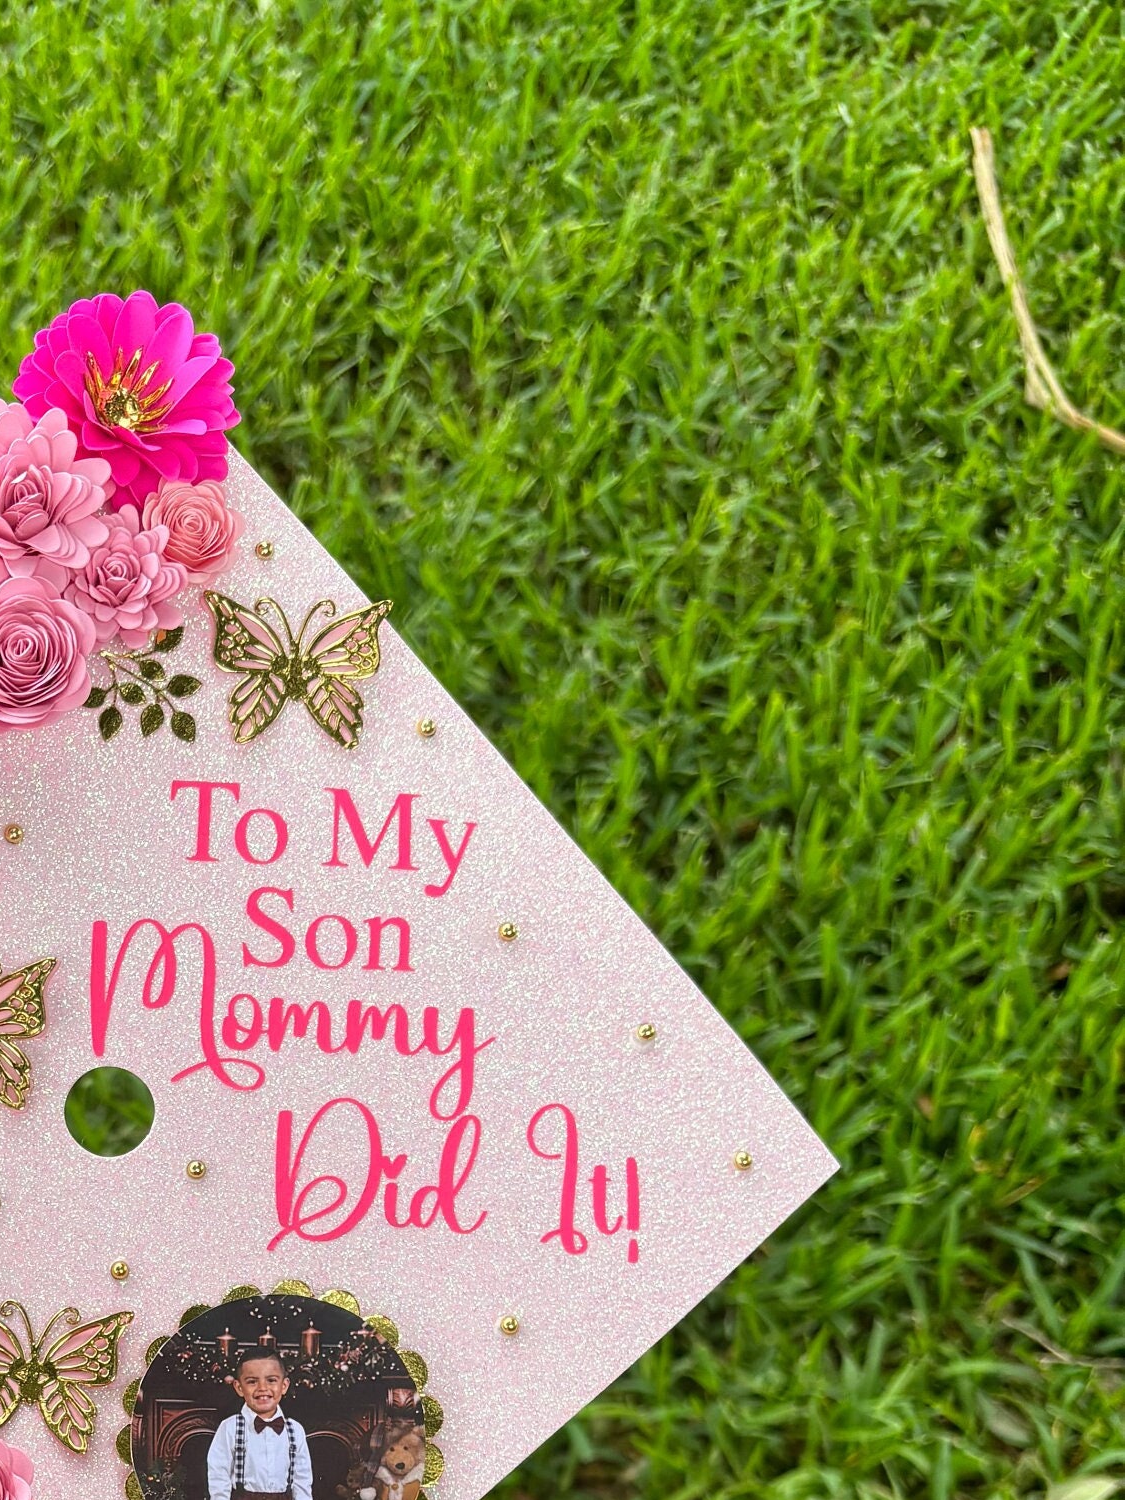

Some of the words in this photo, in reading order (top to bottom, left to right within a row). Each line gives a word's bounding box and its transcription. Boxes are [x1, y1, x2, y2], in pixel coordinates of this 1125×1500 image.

[170, 780, 289, 865] To
[322, 787, 477, 897] My
[242, 886, 415, 972] Son
[90, 918, 496, 1121] Mommy
[266, 1097, 487, 1252] Did
[526, 1103, 640, 1264] It!
